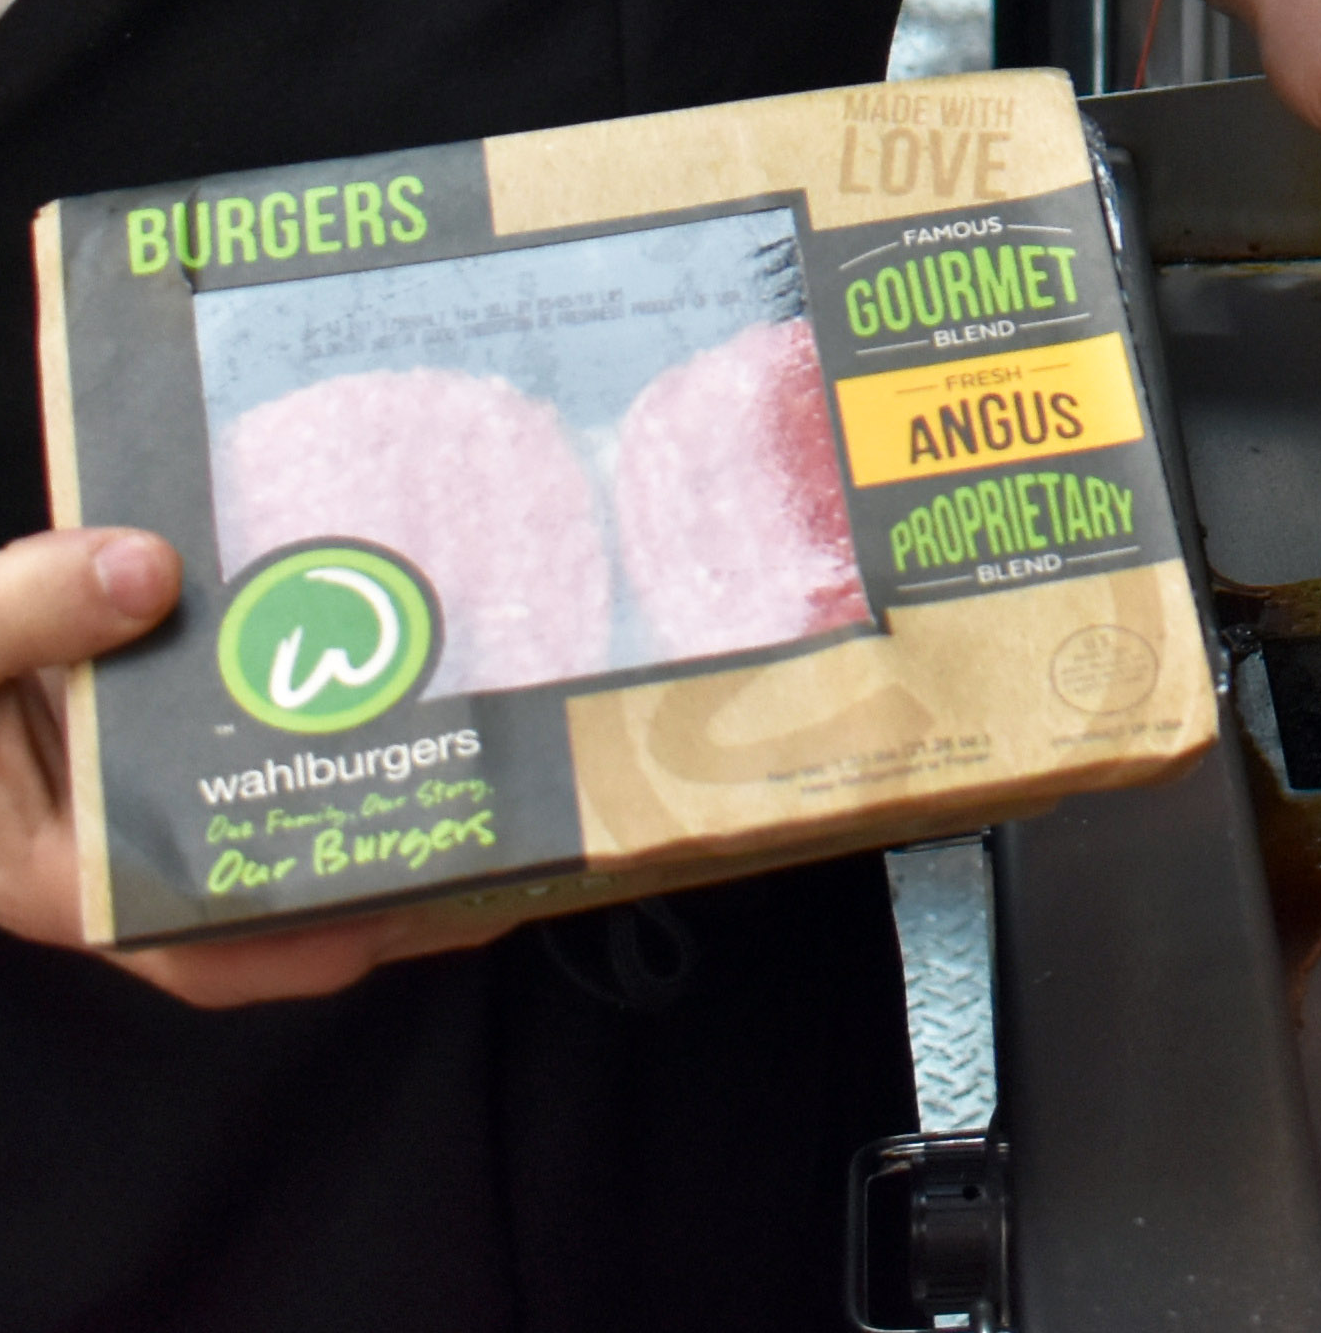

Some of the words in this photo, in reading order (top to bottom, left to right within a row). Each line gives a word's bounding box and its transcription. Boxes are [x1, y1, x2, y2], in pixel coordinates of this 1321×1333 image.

[842, 93, 928, 125] MADE
[939, 95, 1016, 127] WITH
[838, 124, 1011, 200] LOVE
[127, 175, 428, 276] BURGERS
[903, 216, 1003, 246] FAMOUS
[845, 244, 1078, 336] GOURMET
[933, 319, 1017, 348] BLEND
[944, 365, 1022, 391] FRESH
[909, 390, 1085, 465] ANGUS
[890, 471, 1134, 572] PROPRIETARY
[976, 553, 1063, 584] BLEND
[198, 728, 481, 805] wahlburgers
[360, 792, 407, 819] Our
[206, 848, 297, 895] Our
[312, 809, 498, 876] Burgers
